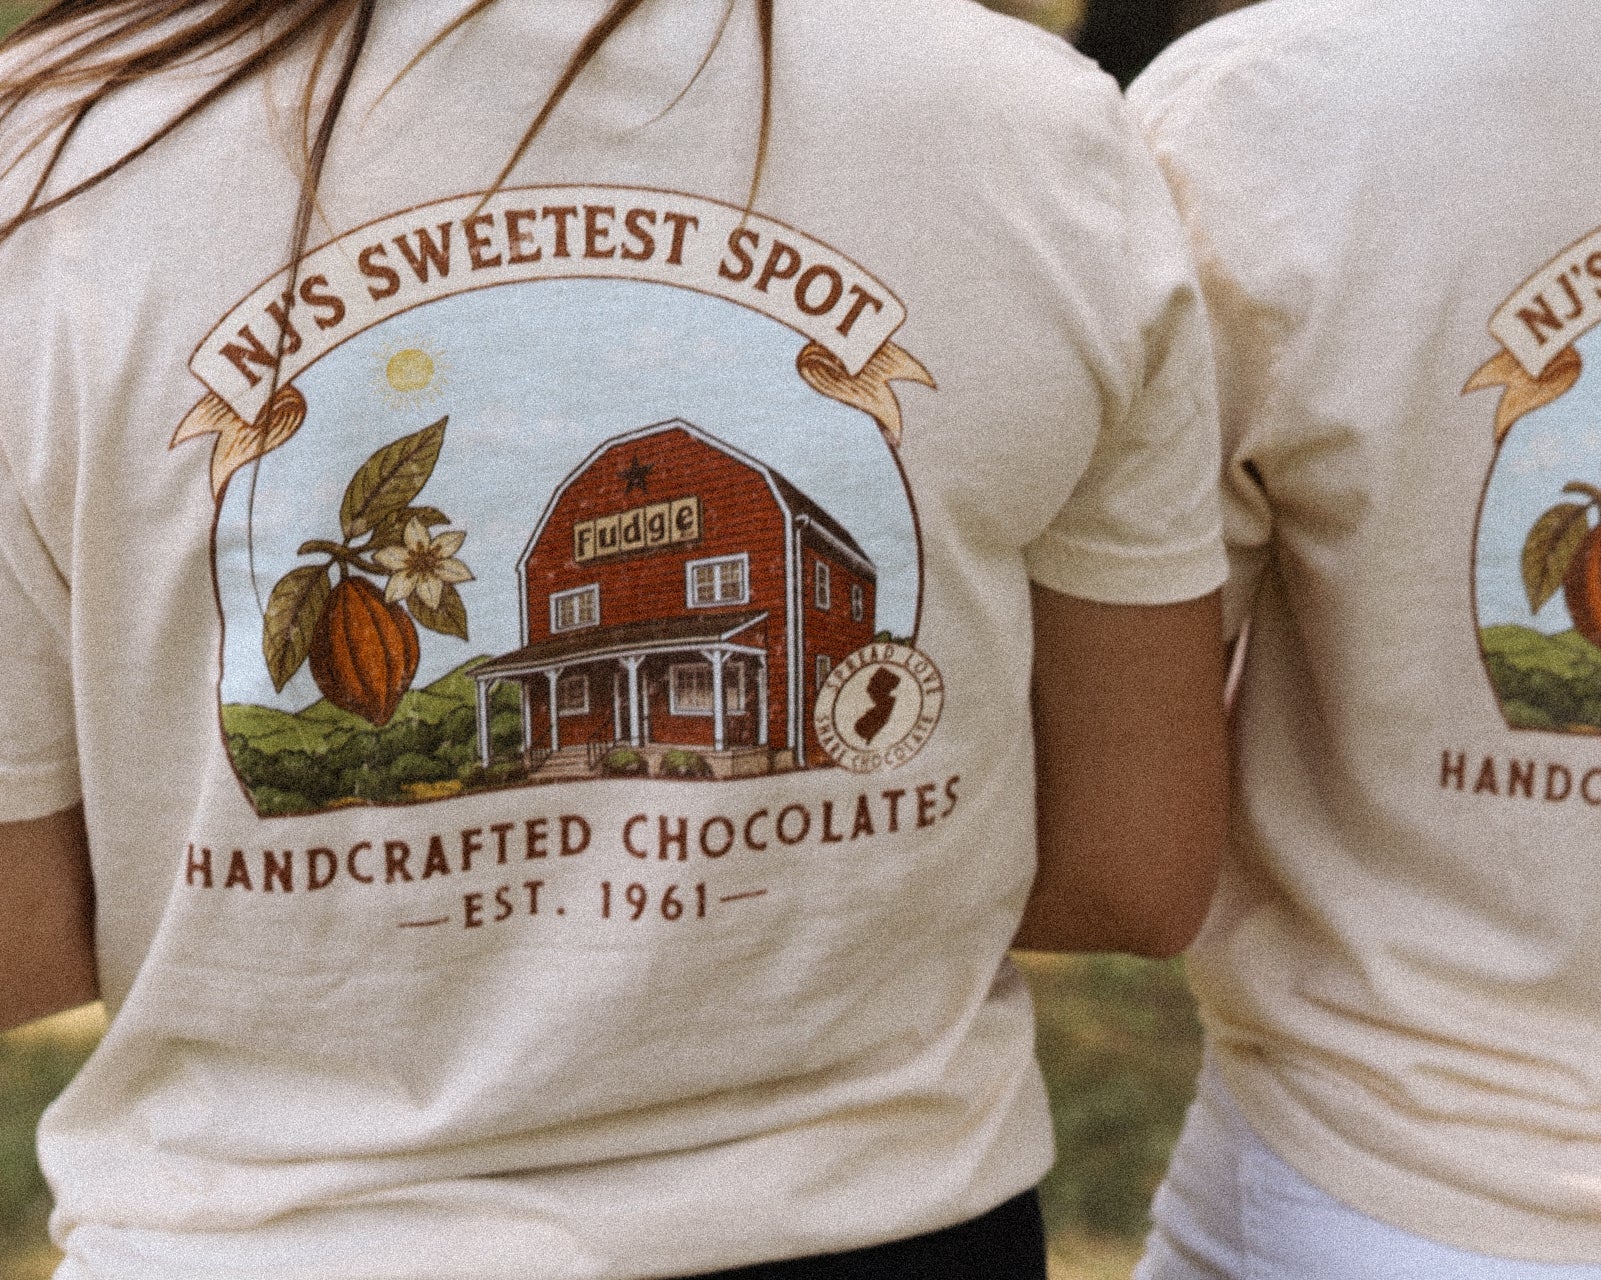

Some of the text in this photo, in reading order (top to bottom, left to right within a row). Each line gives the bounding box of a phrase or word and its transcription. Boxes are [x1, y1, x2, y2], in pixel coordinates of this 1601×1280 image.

[358, 204, 699, 301] SWEETEST
[718, 228, 884, 337] SPOT
[577, 504, 694, 558] Fudge
[827, 644, 943, 696] SPREAD LOVE
[816, 714, 934, 768] SHARE CHOCOLATE
[186, 774, 961, 894] HANDCRAFTED CHOCOLATES
[464, 879, 707, 929] EST. 1961
